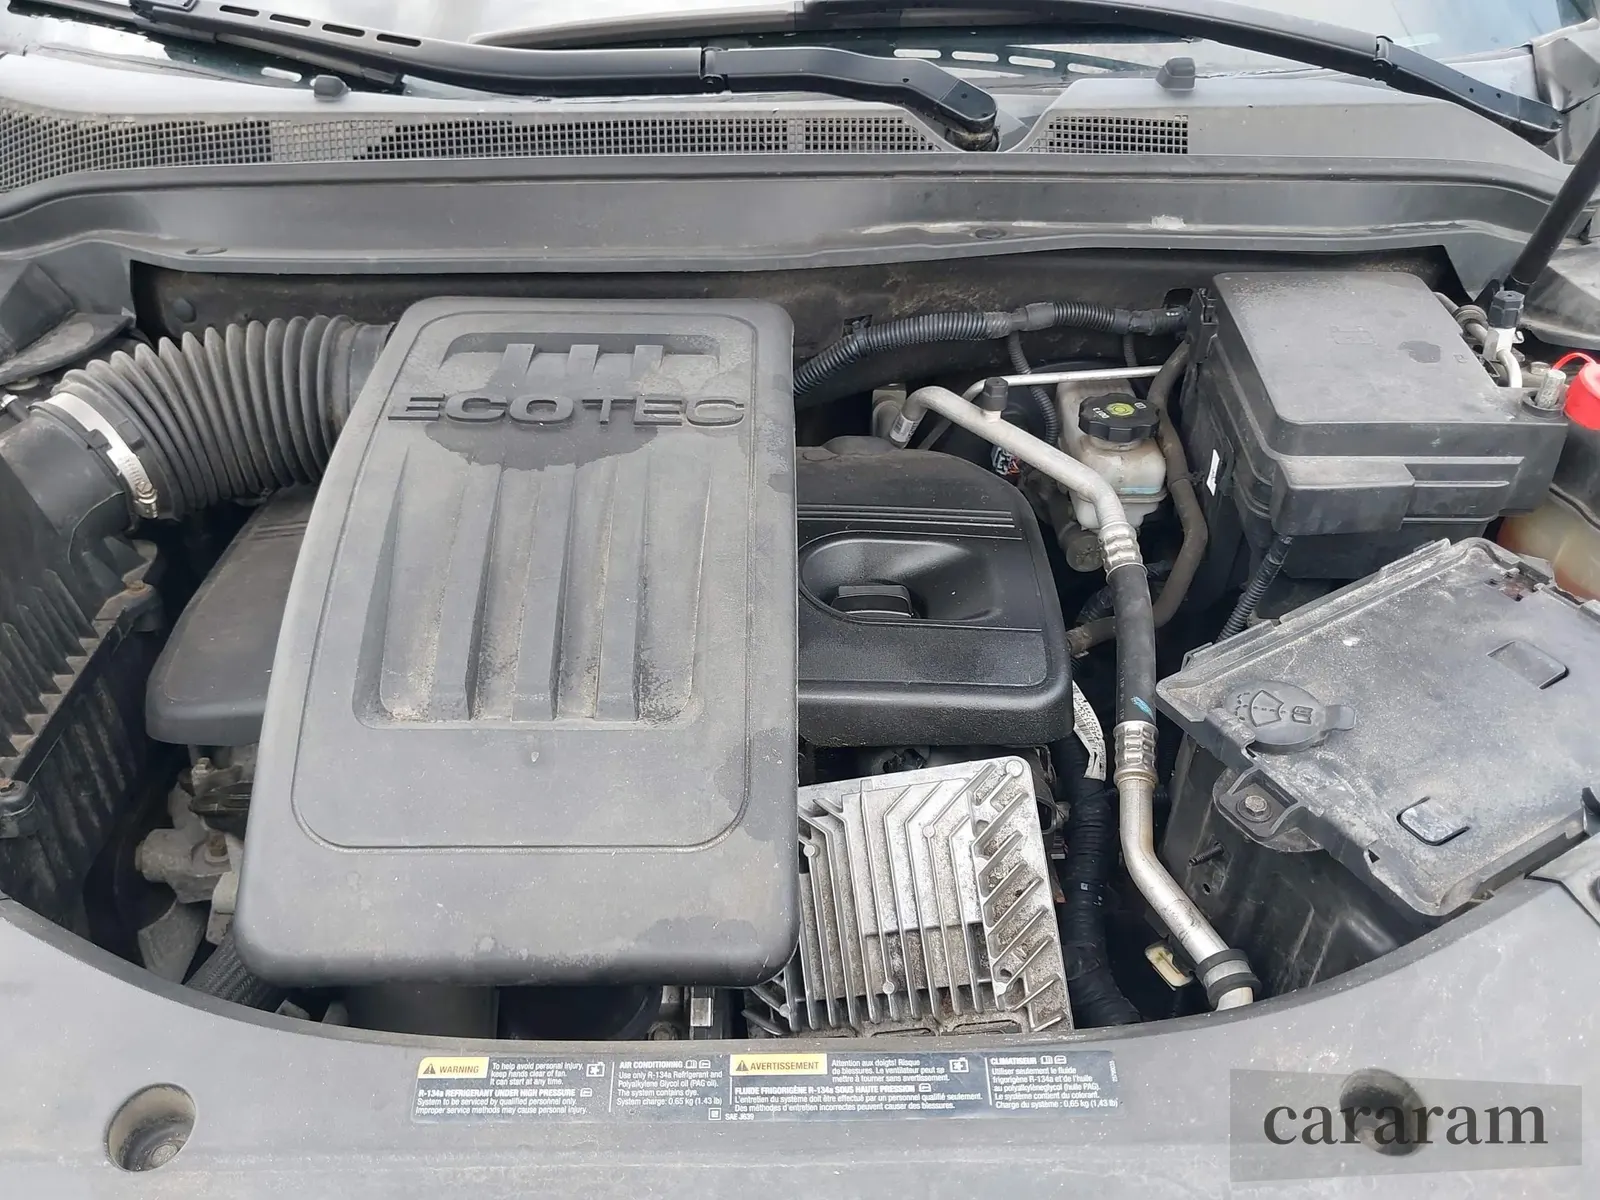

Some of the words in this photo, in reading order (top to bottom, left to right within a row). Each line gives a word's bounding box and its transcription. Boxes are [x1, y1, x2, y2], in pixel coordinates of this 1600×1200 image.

[388, 393, 744, 427] ECOTEC
[440, 1065, 480, 1074] WARNING
[492, 1062, 500, 1070] To
[501, 1062, 515, 1070] help
[516, 1062, 534, 1070] avoid
[535, 1062, 563, 1070] personal
[750, 1062, 819, 1070] AVERTISSEMENT
[618, 1080, 658, 1089] Polyalkylene
[660, 1080, 679, 1089] Glycol
[680, 1080, 689, 1088] oil
[690, 1080, 706, 1088] (PAG
[706, 1080, 719, 1088] oil).
[618, 1089, 630, 1097] The
[632, 1089, 654, 1097] system
[656, 1089, 684, 1097] contains
[685, 1089, 699, 1097] dye.
[417, 1098, 442, 1106] System
[443, 1098, 450, 1106] to
[451, 1098, 460, 1106] be
[461, 1098, 489, 1106] serviced
[490, 1098, 498, 1106] by
[500, 1098, 527, 1106] qualified
[528, 1098, 561, 1106] personnel
[616, 1098, 642, 1106] System
[685, 1098, 694, 1106] kg
[714, 1098, 722, 1106] lb)
[415, 1106, 445, 1114] Improper
[446, 1106, 471, 1114] service
[472, 1106, 500, 1114] methods
[502, 1106, 516, 1114] may
[518, 1106, 537, 1114] cause
[539, 1106, 567, 1114] personal
